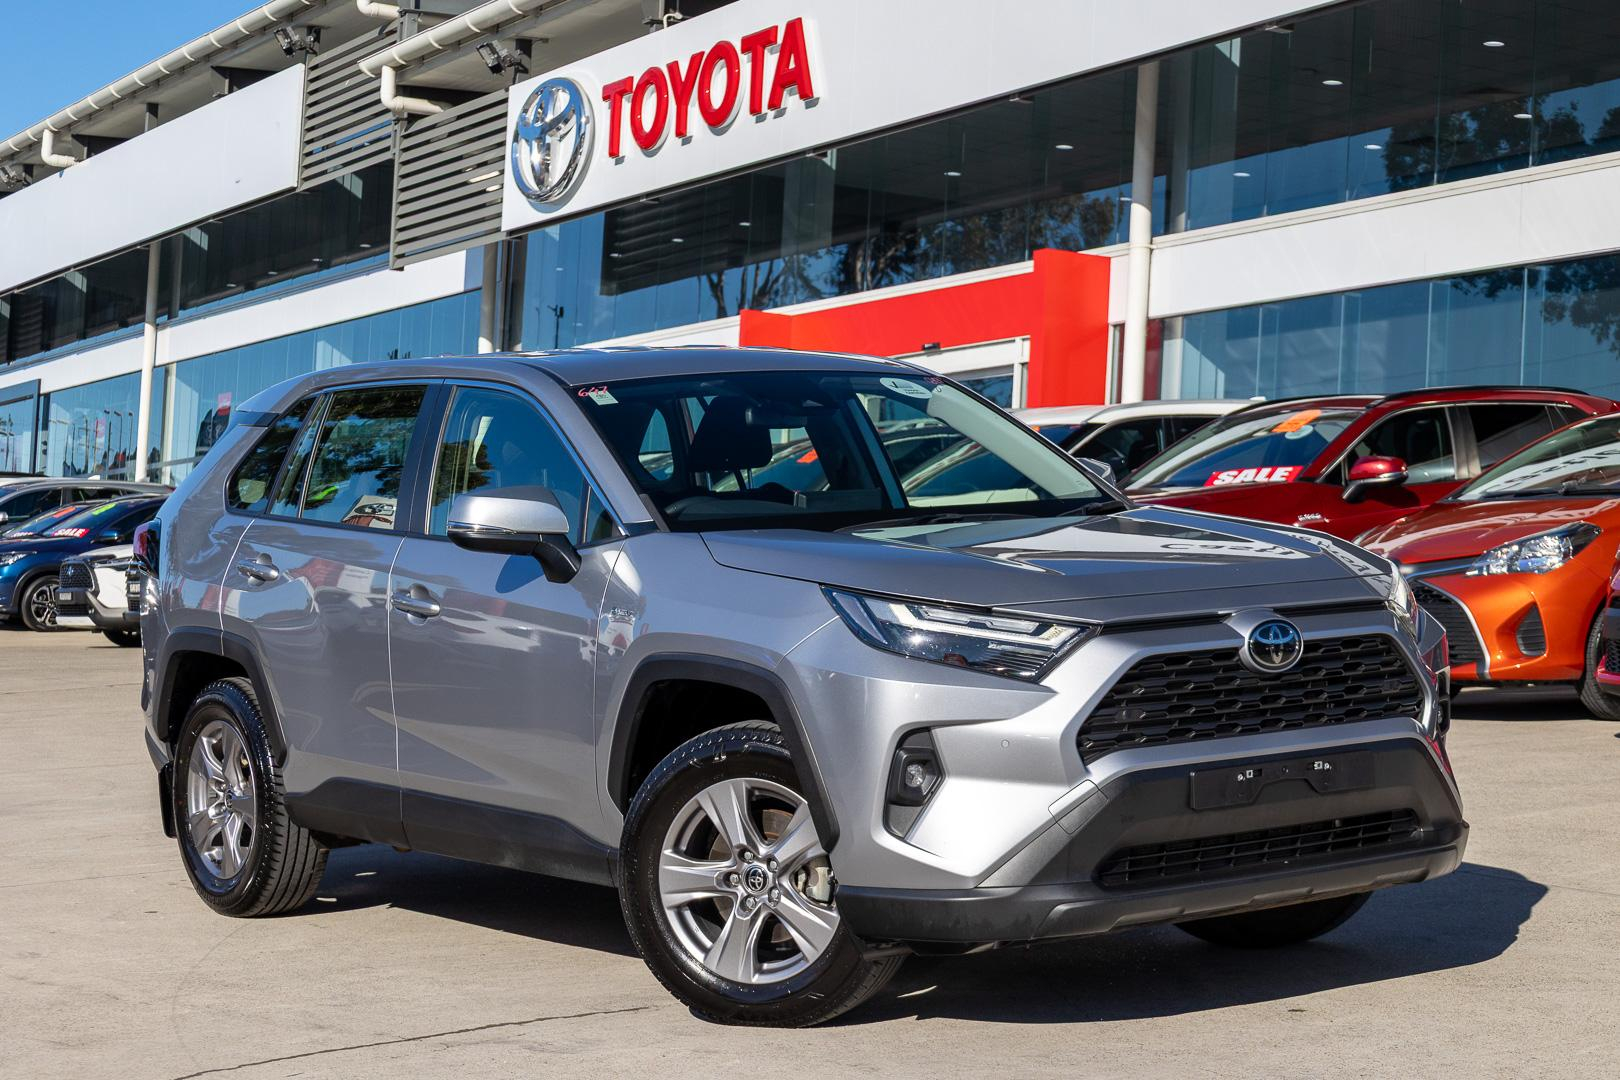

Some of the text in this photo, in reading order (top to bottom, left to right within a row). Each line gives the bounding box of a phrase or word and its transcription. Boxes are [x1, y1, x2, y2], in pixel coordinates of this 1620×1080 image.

[602, 17, 813, 158] TOYOTA
[1213, 466, 1294, 486] SALE
[54, 528, 86, 538] SALE
